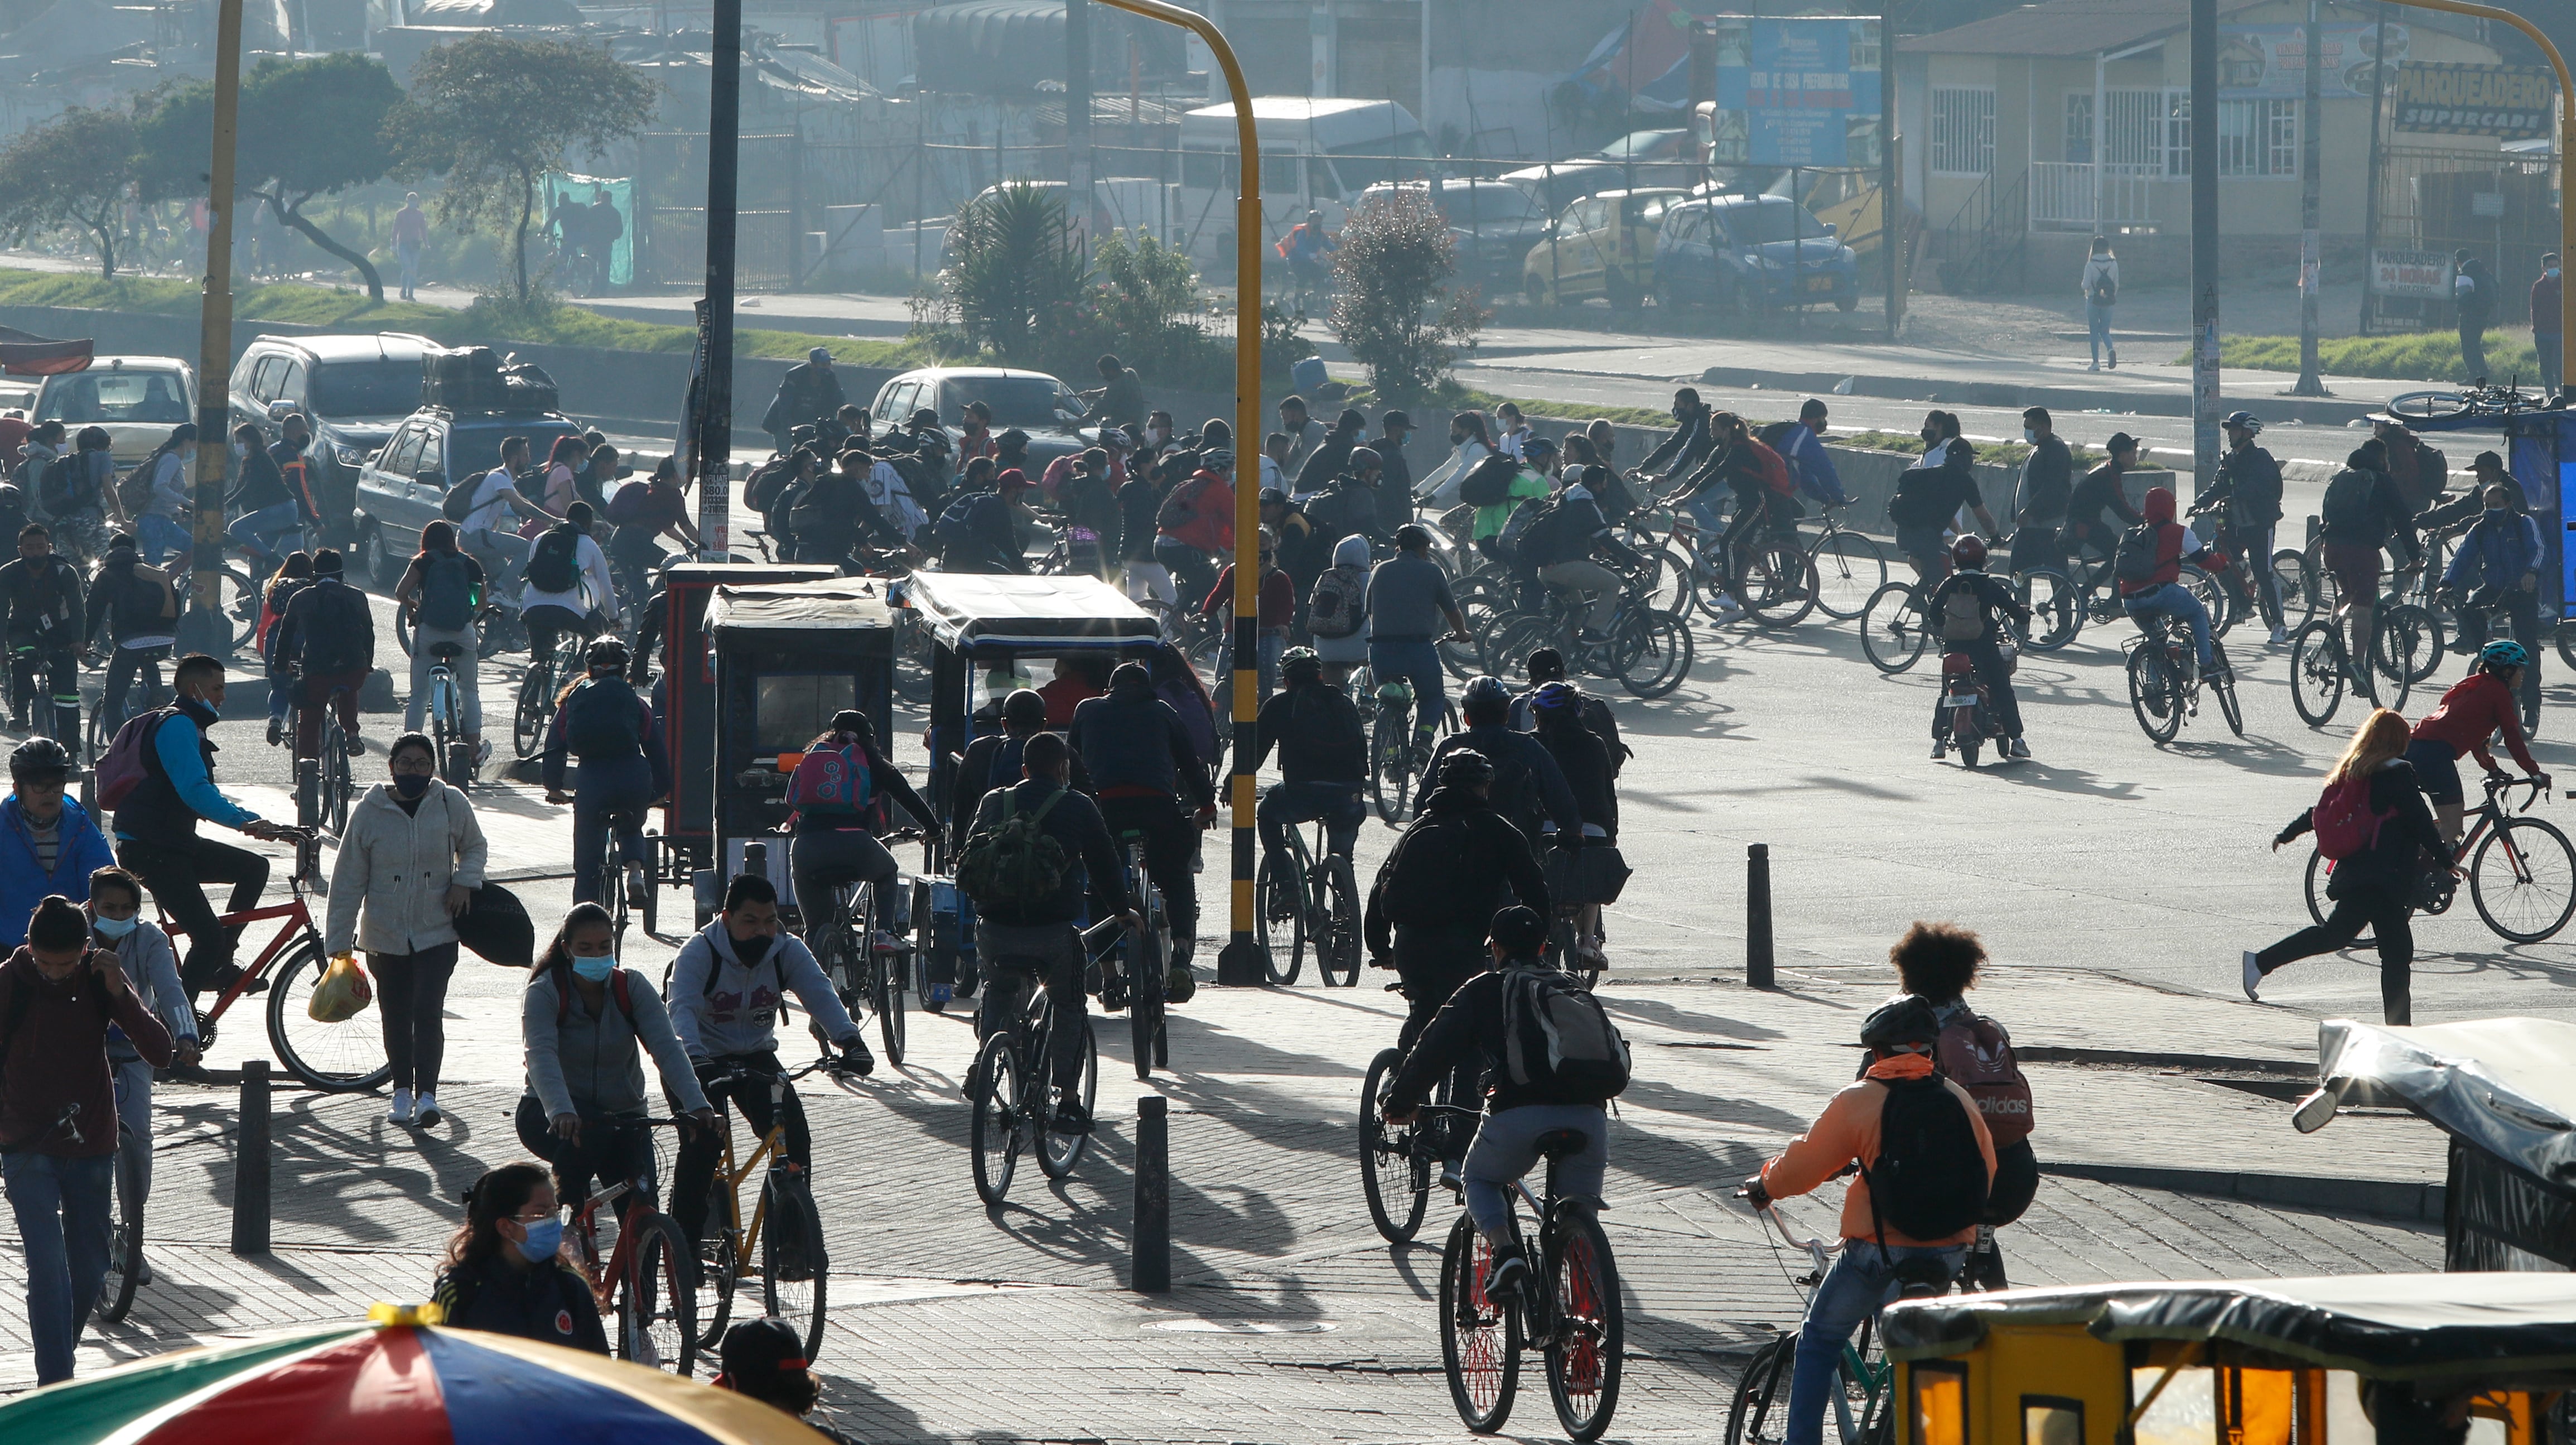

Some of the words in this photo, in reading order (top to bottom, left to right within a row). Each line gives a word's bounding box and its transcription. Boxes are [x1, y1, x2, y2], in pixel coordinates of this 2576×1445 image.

[2398, 68, 2550, 110] PARQUEADERO
[2404, 109, 2540, 128] SUPERCADE
[2377, 251, 2446, 267] PARQUEADERO
[2380, 267, 2396, 282] 24
[2399, 268, 2441, 286] HORAS
[2398, 284, 2411, 293] HAY
[1975, 1095, 2028, 1114] didas
